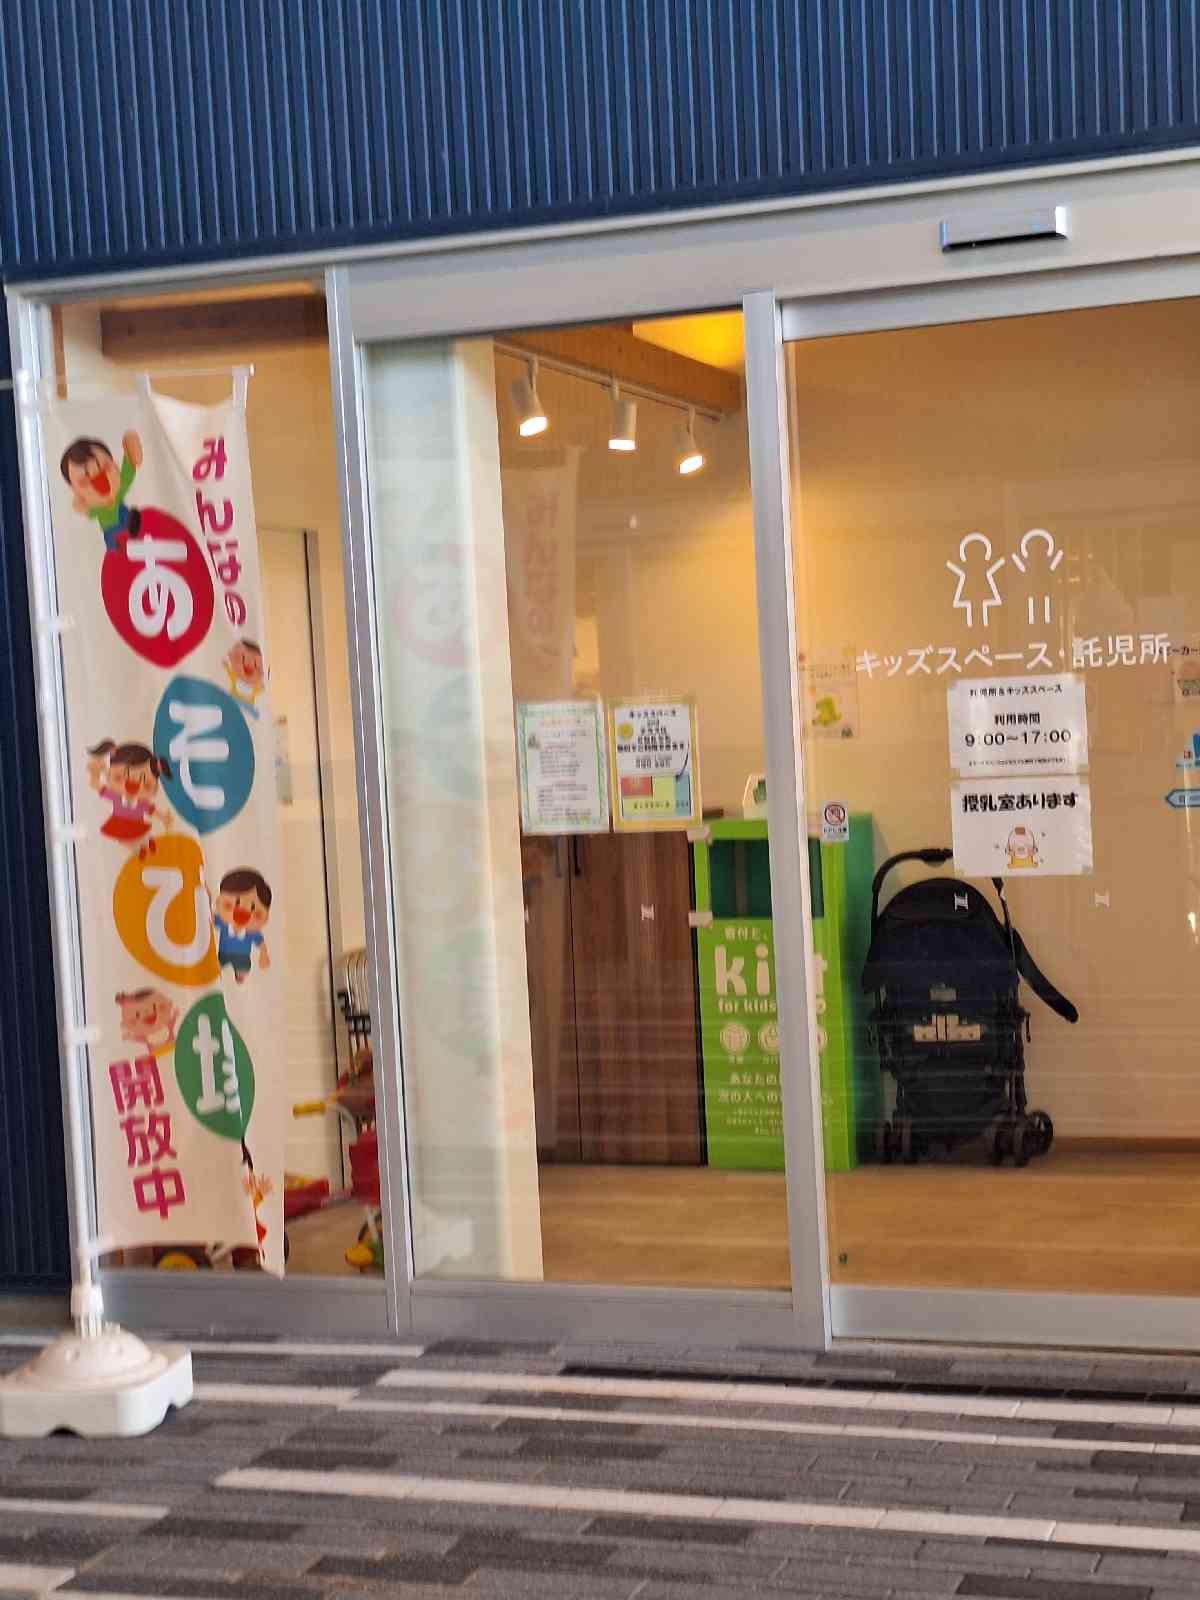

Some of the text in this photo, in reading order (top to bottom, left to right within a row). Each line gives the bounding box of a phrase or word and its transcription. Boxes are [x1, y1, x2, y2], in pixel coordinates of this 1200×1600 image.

[192, 435, 247, 627] みんなの
[994, 711, 1041, 726] 利用時間
[962, 791, 1078, 813] 授乳室あります
[108, 1055, 186, 1219] 開放中
